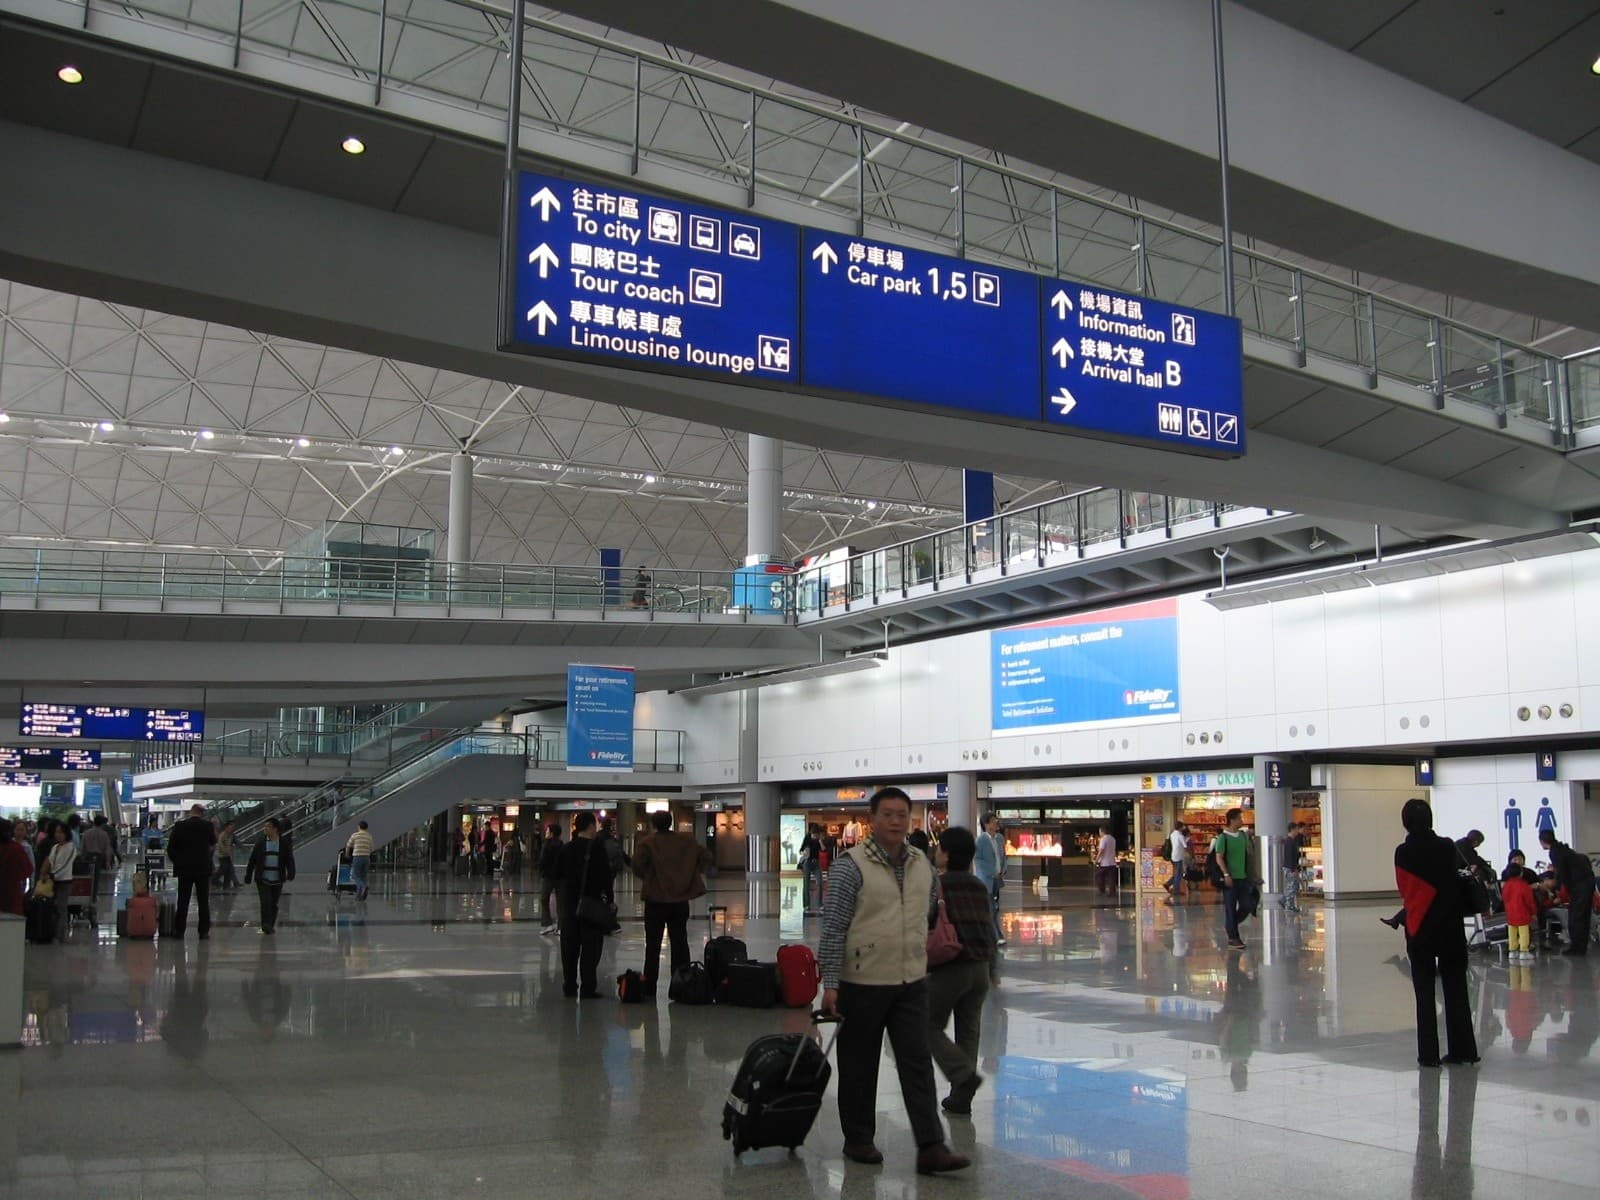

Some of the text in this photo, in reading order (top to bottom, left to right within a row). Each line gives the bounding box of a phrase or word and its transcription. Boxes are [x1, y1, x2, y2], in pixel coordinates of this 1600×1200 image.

[572, 188, 639, 219] 往市區
[572, 212, 641, 245] To city
[571, 242, 661, 278] 團隊巴士
[848, 242, 904, 271] 停車場
[570, 268, 684, 305] Tour coach
[848, 265, 878, 286] Car
[884, 276, 921, 296] park
[928, 267, 967, 300] 1,5
[570, 300, 682, 338] 專車候車處
[1080, 290, 1143, 320] 機場資訊
[1080, 312, 1165, 343] Information
[571, 327, 755, 373] Limousine lounge
[1081, 337, 1145, 367] 接機大堂
[1082, 360, 1181, 388] Arrival hall B
[597, 751, 625, 761] Fidelity
